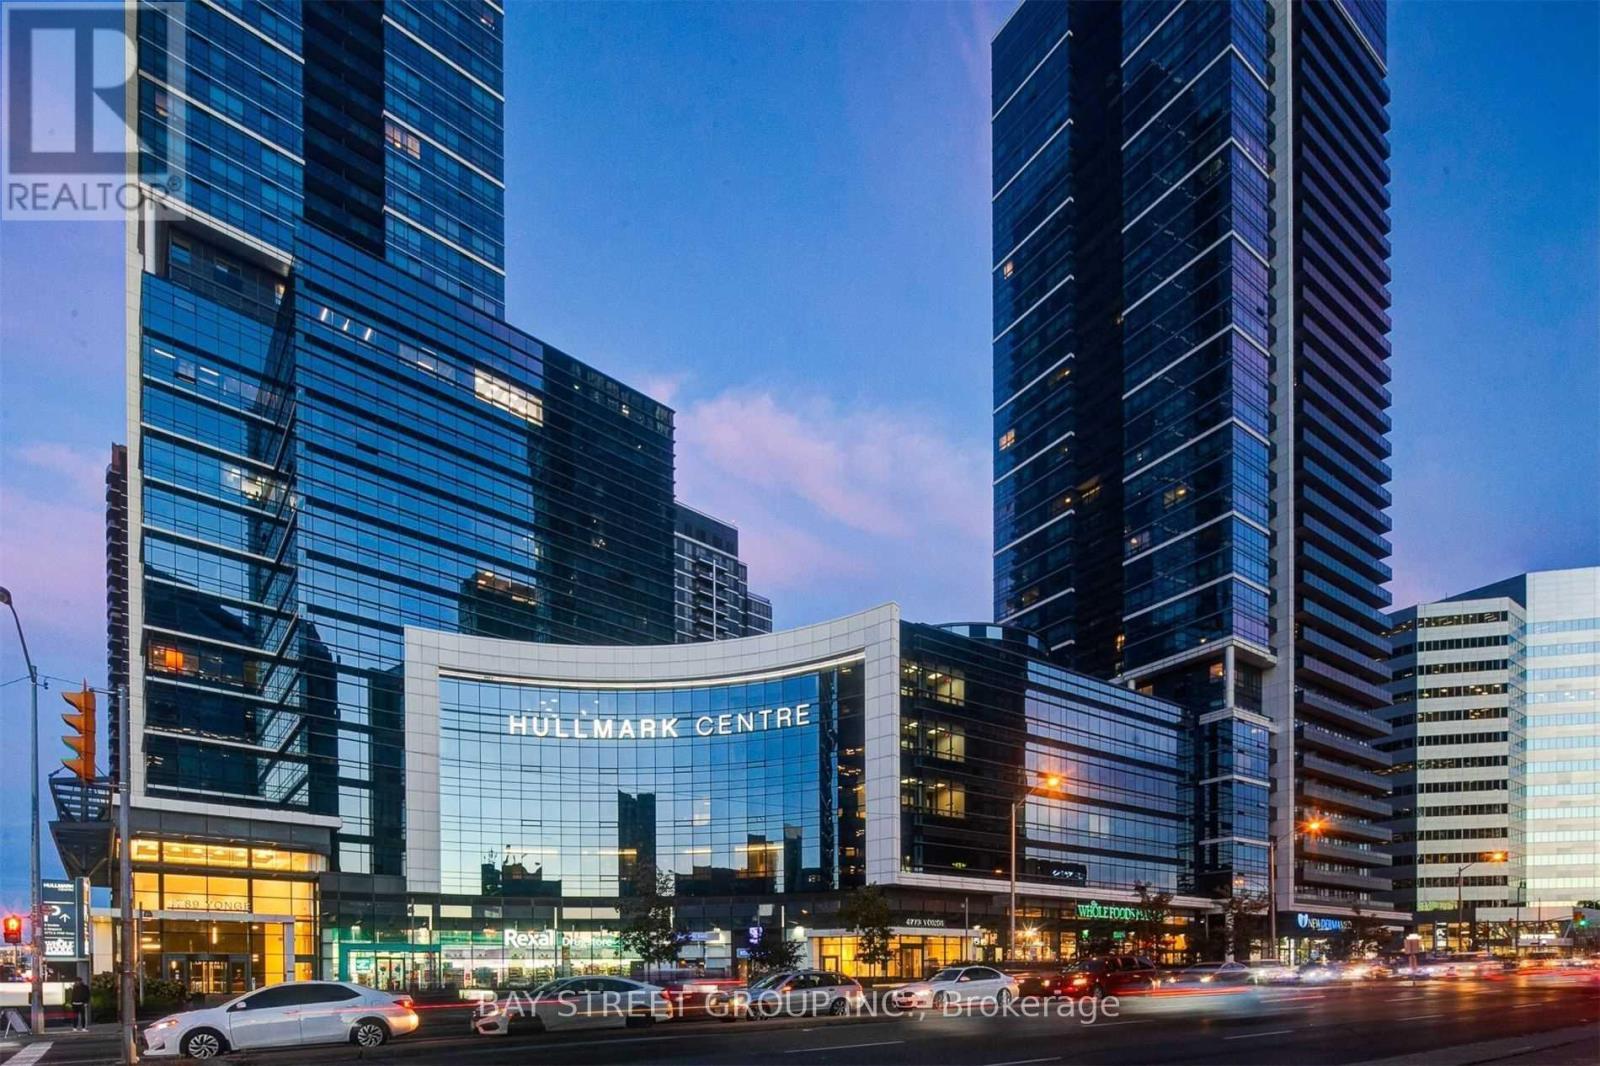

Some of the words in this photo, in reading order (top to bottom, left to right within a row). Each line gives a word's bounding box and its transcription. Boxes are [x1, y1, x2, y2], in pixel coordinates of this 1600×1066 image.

[508, 713, 679, 739] HULLMARK
[696, 703, 810, 736] CENTRE
[204, 899, 251, 911] YONGE
[1077, 902, 1108, 918] WHOLE
[1109, 906, 1135, 919] FOODS
[504, 929, 557, 947] Rexal
